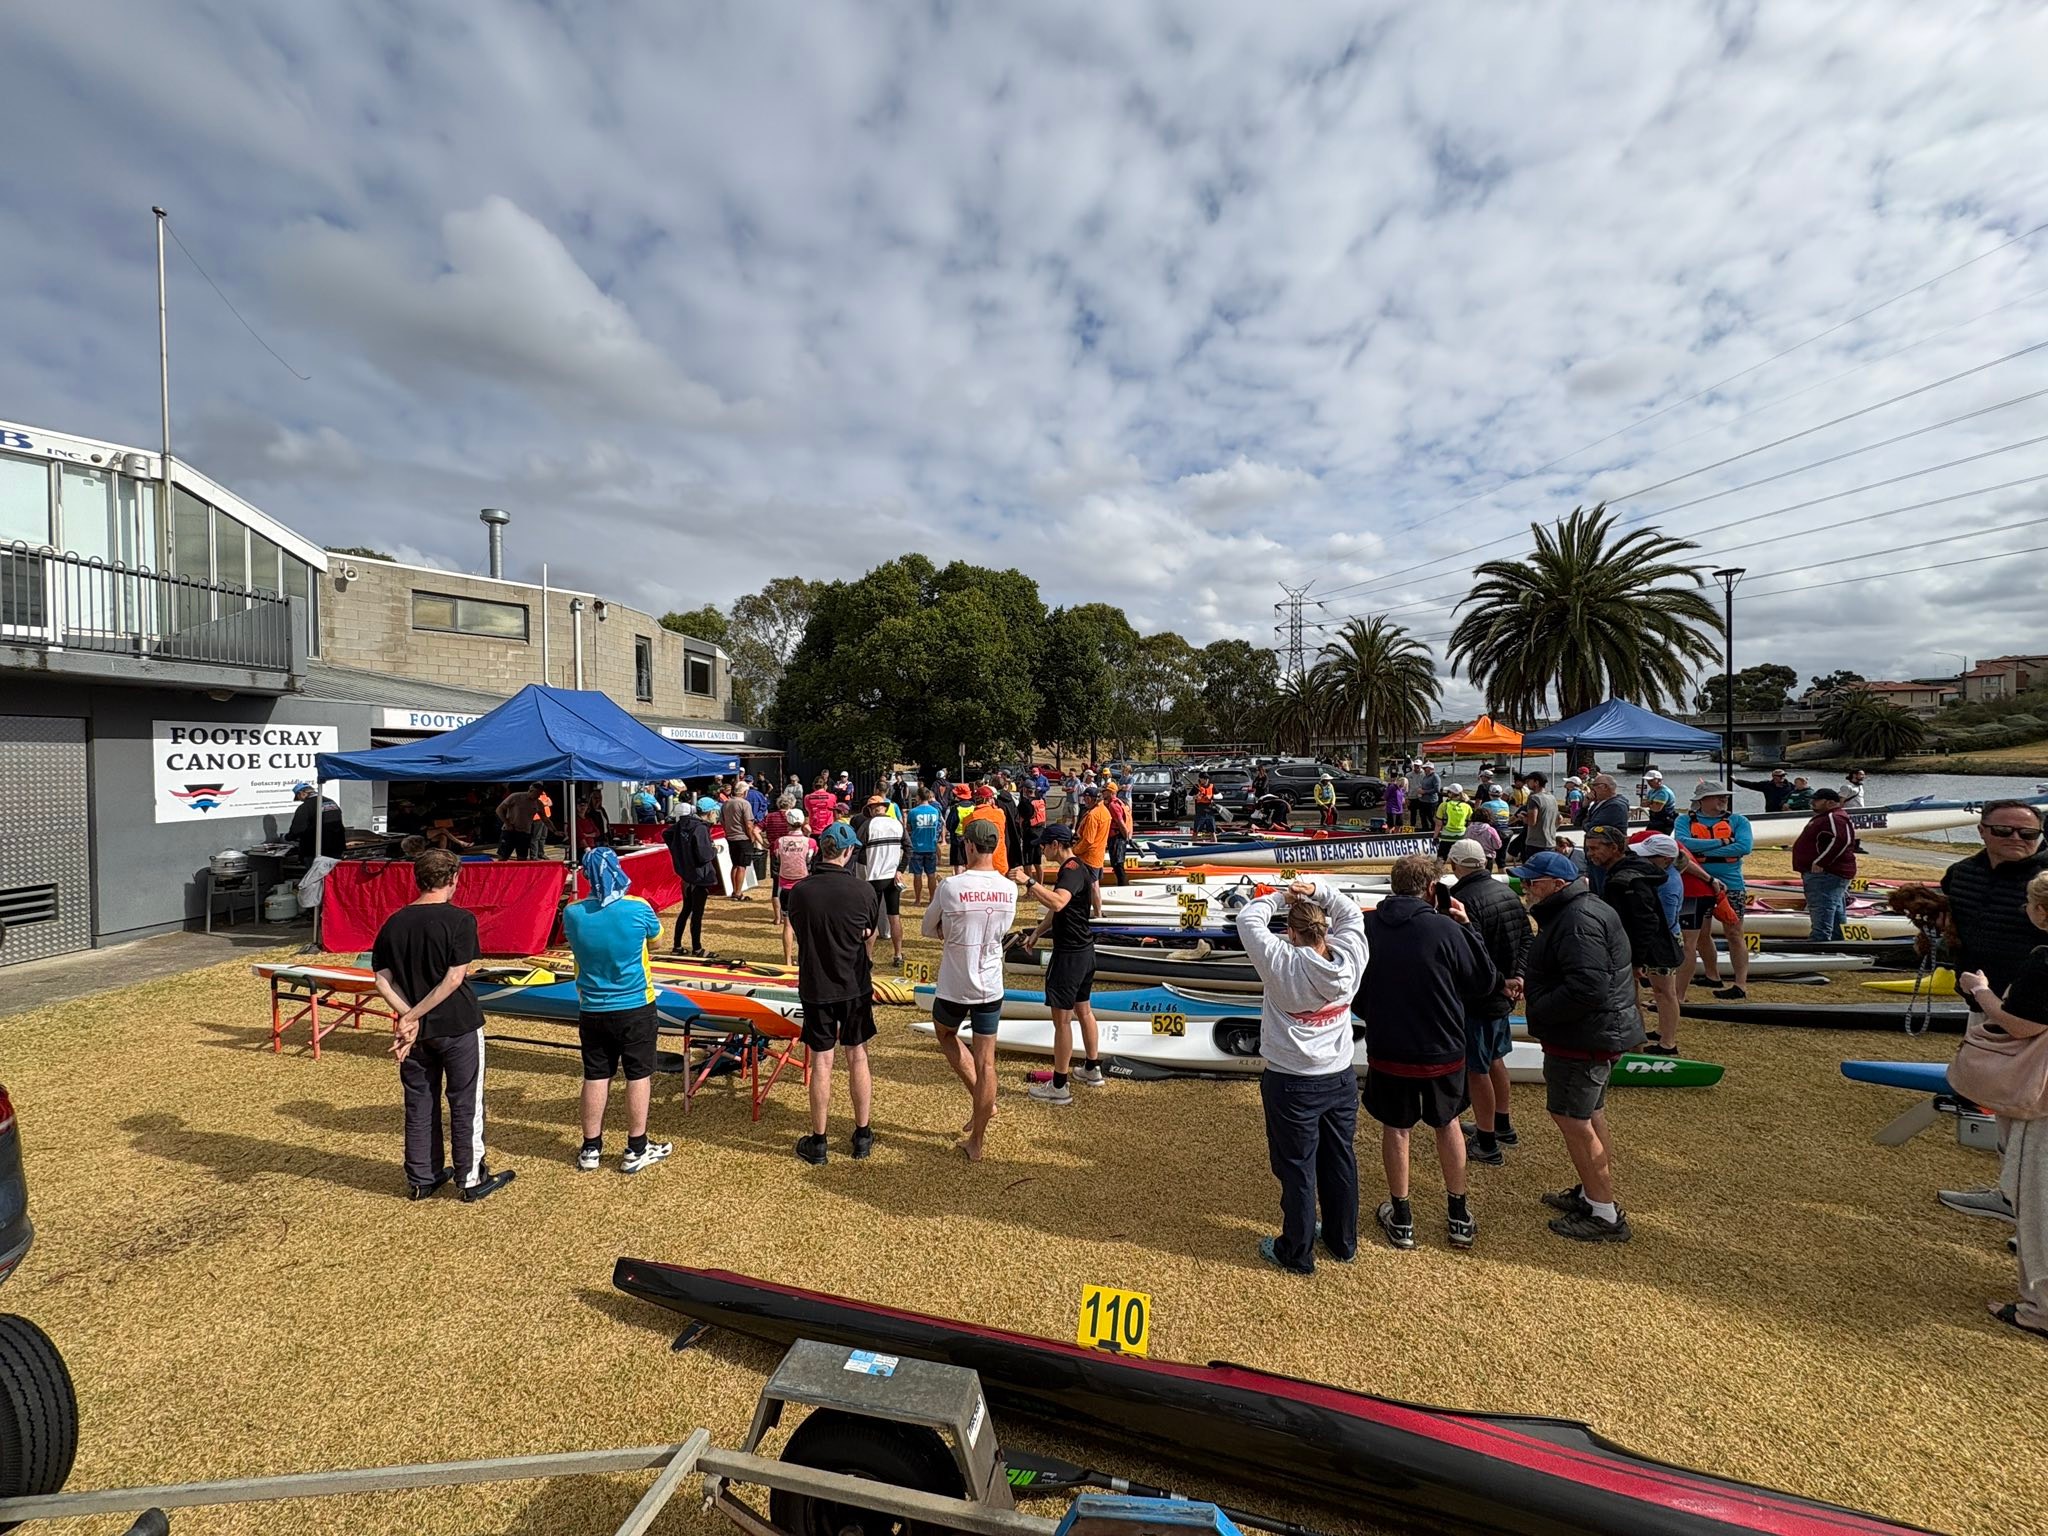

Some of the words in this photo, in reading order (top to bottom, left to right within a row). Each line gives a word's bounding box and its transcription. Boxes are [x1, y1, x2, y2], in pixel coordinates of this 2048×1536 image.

[170, 727, 322, 746] FOOTSCRAY
[671, 729, 705, 739] FOOTSCRAY
[707, 731, 725, 740] CANOE
[726, 732, 738, 740] CLUB
[166, 753, 261, 771] CANOE
[268, 753, 317, 769] CLU
[1273, 846, 1319, 864] WESTERN
[1321, 843, 1364, 861] BEACHES
[1366, 839, 1420, 858] OUTRIGGER
[1281, 869, 1296, 879] 206
[1166, 885, 1182, 893] 614
[959, 891, 1014, 903] MERCANTILE
[1187, 904, 1205, 915] 527
[1181, 914, 1201, 927] 502
[1843, 926, 1870, 940] 508
[905, 961, 929, 980] 516
[1130, 1001, 1162, 1012] Rebel
[1166, 1003, 1178, 1013] 46
[1153, 1015, 1184, 1033] 526
[1086, 1291, 1145, 1346] 110
